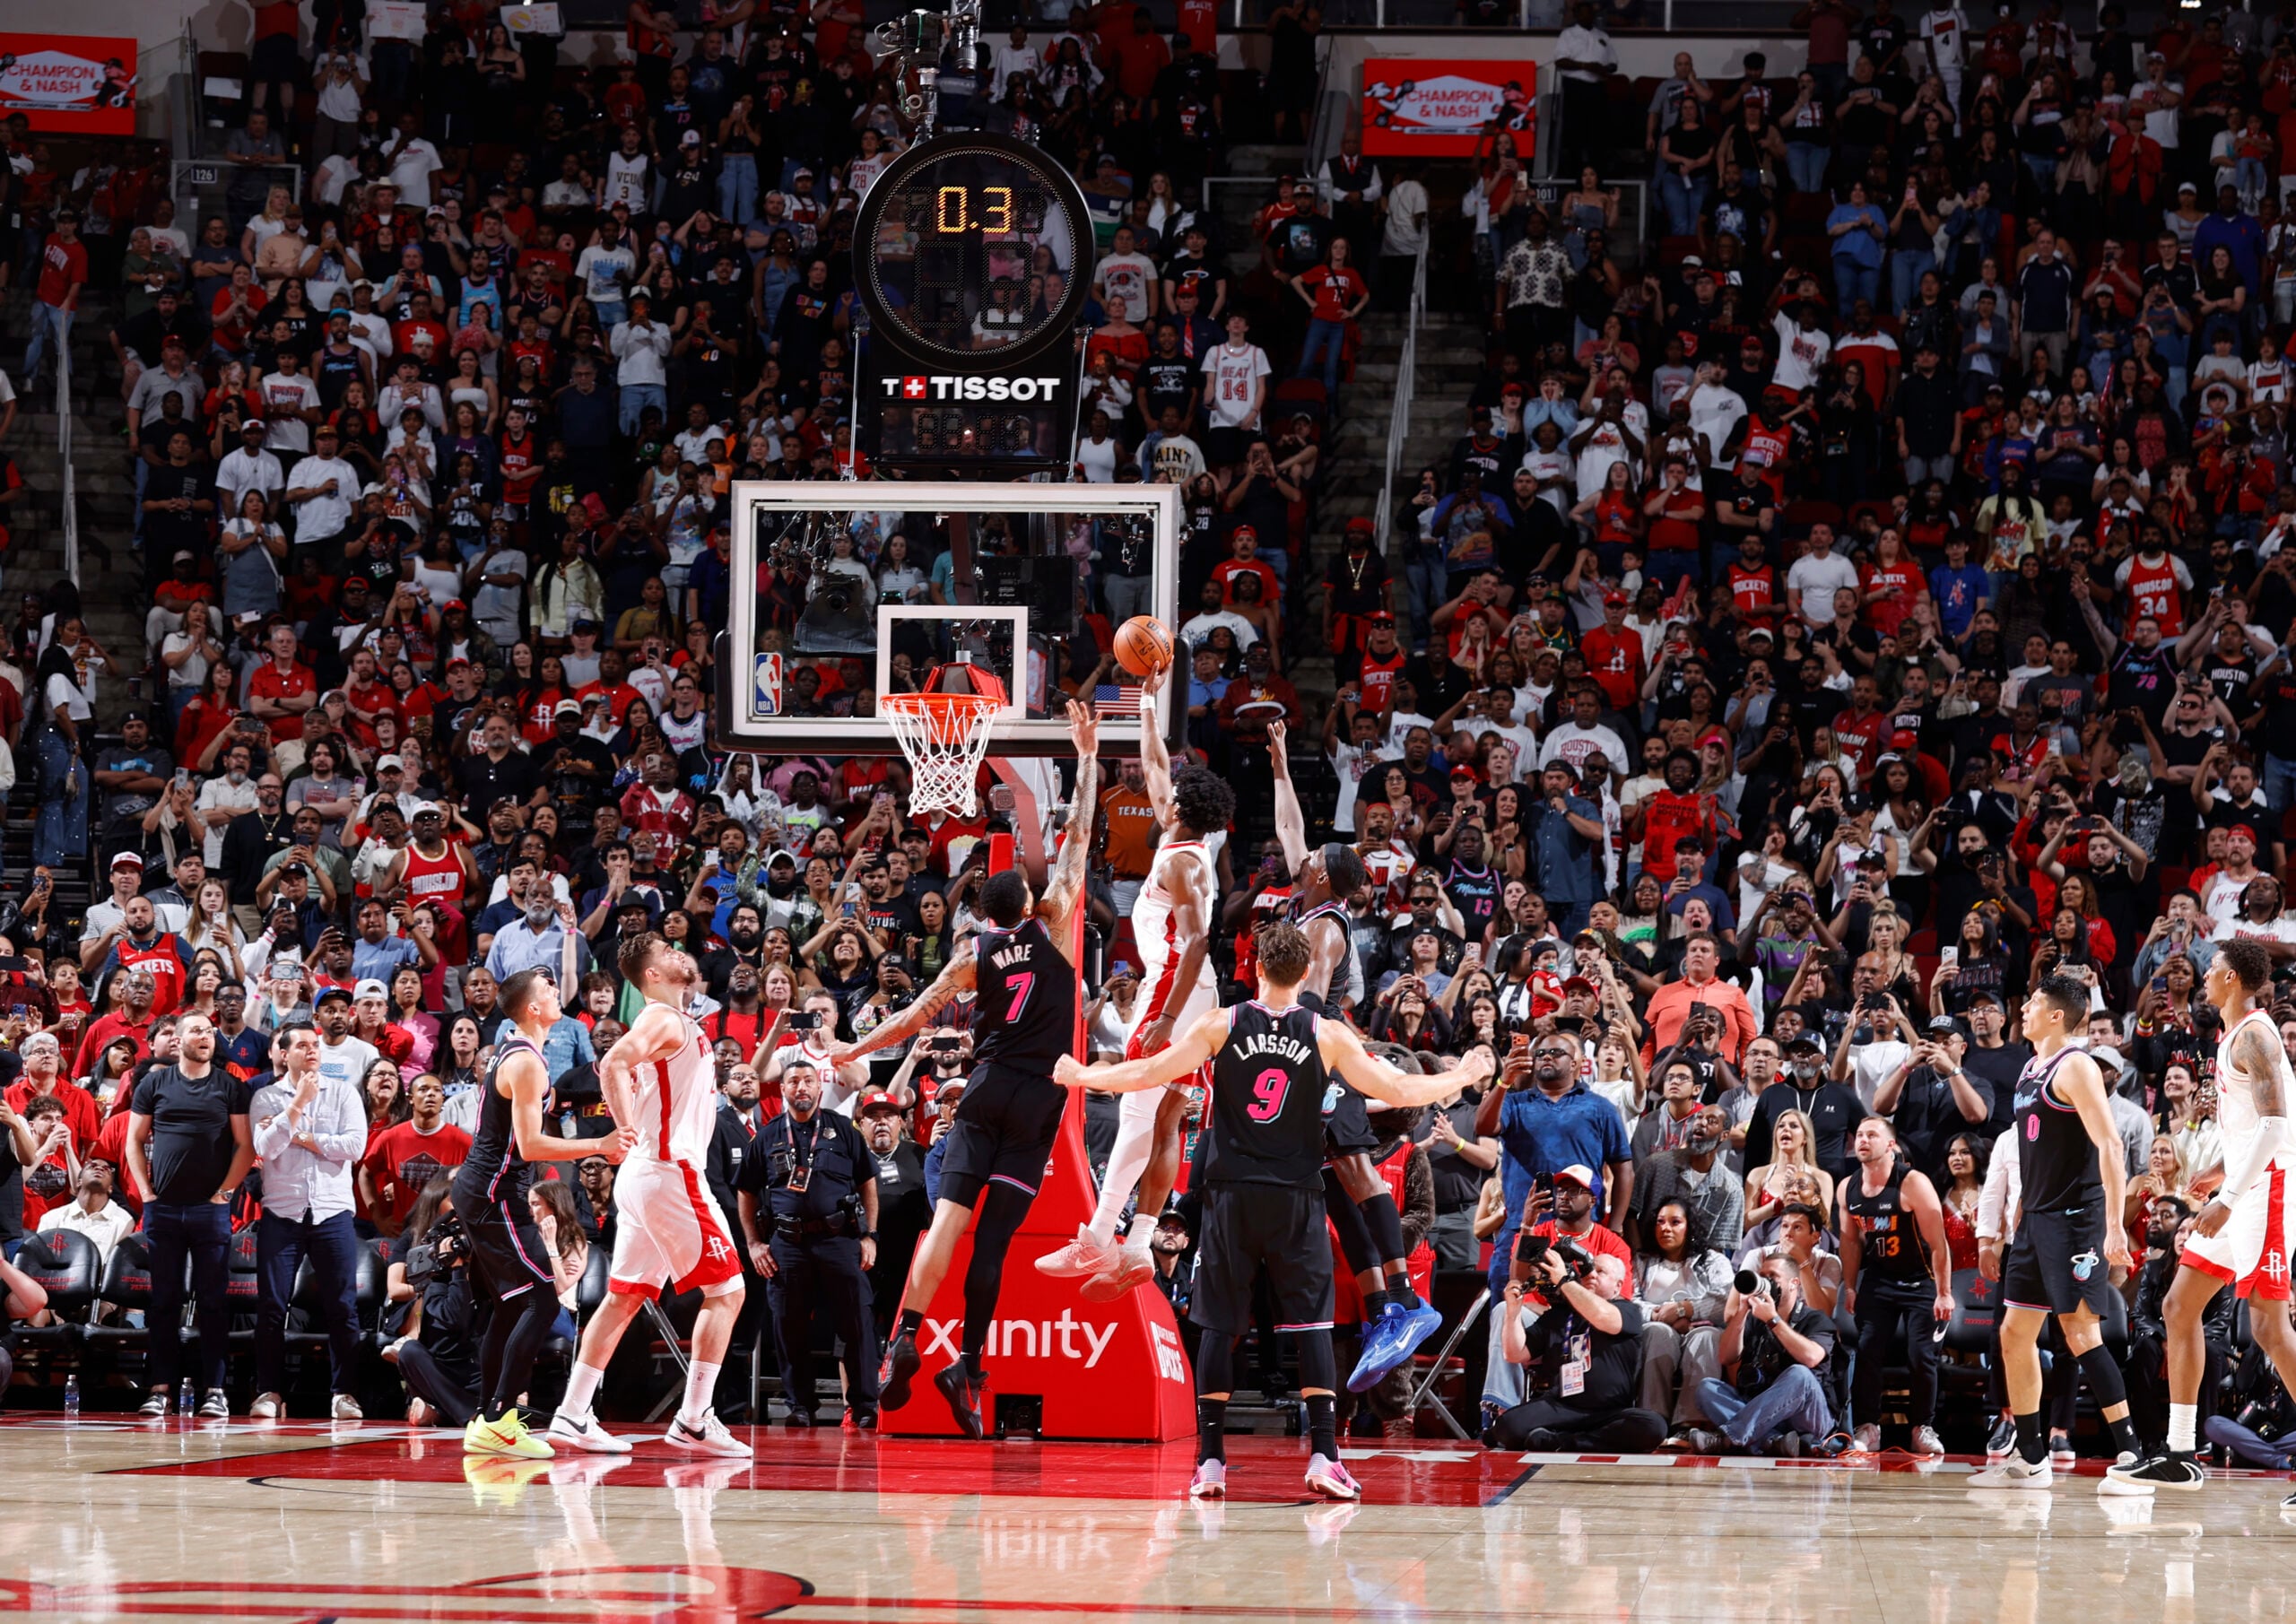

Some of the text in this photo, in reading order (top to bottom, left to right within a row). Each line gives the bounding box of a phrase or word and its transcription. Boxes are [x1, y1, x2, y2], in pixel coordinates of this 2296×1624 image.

[8, 65, 95, 80] CHAMPION
[21, 81, 82, 94] & NASH
[1405, 89, 1494, 104] CHAMPION
[1420, 105, 1481, 119] & NASH
[196, 169, 212, 180] 126
[617, 171, 638, 185] VCU
[854, 174, 867, 188] 28
[621, 186, 630, 199] 3
[936, 186, 1012, 233] 0.3
[700, 349, 719, 361] 40
[1221, 366, 1249, 378] HEAT
[930, 377, 1060, 402] TISSOT
[1222, 379, 1248, 402] 14
[1752, 437, 1785, 456] ROCKETS
[182, 476, 195, 524] ROCTS
[1195, 517, 1209, 530] 28
[1733, 579, 1770, 596] ROCKETS
[1748, 592, 1754, 610] 1
[2139, 595, 2168, 617] 34
[1146, 621, 1171, 656] Wilson
[2135, 674, 2159, 690] 78
[2211, 668, 2249, 685] HOUSTON
[1377, 685, 1386, 703] 7
[2225, 682, 2233, 700] 7
[757, 699, 771, 711] NBA
[1560, 739, 1602, 754] HOUSTON
[1854, 749, 1864, 763] 3
[1118, 806, 1153, 818] TEXAS
[1454, 882, 1494, 896] Miami
[1474, 898, 1493, 916] 13
[867, 916, 902, 930] LTURE
[991, 944, 1033, 970] WARE
[1005, 971, 1036, 1024] 7
[1232, 1033, 1312, 1065] LARSSON
[1245, 1068, 1291, 1125] 9
[2026, 1114, 2039, 1141] 0
[1875, 1236, 1900, 1257] 13
[417, 1252, 423, 1264] 2
[923, 1307, 1118, 1370] xinity
